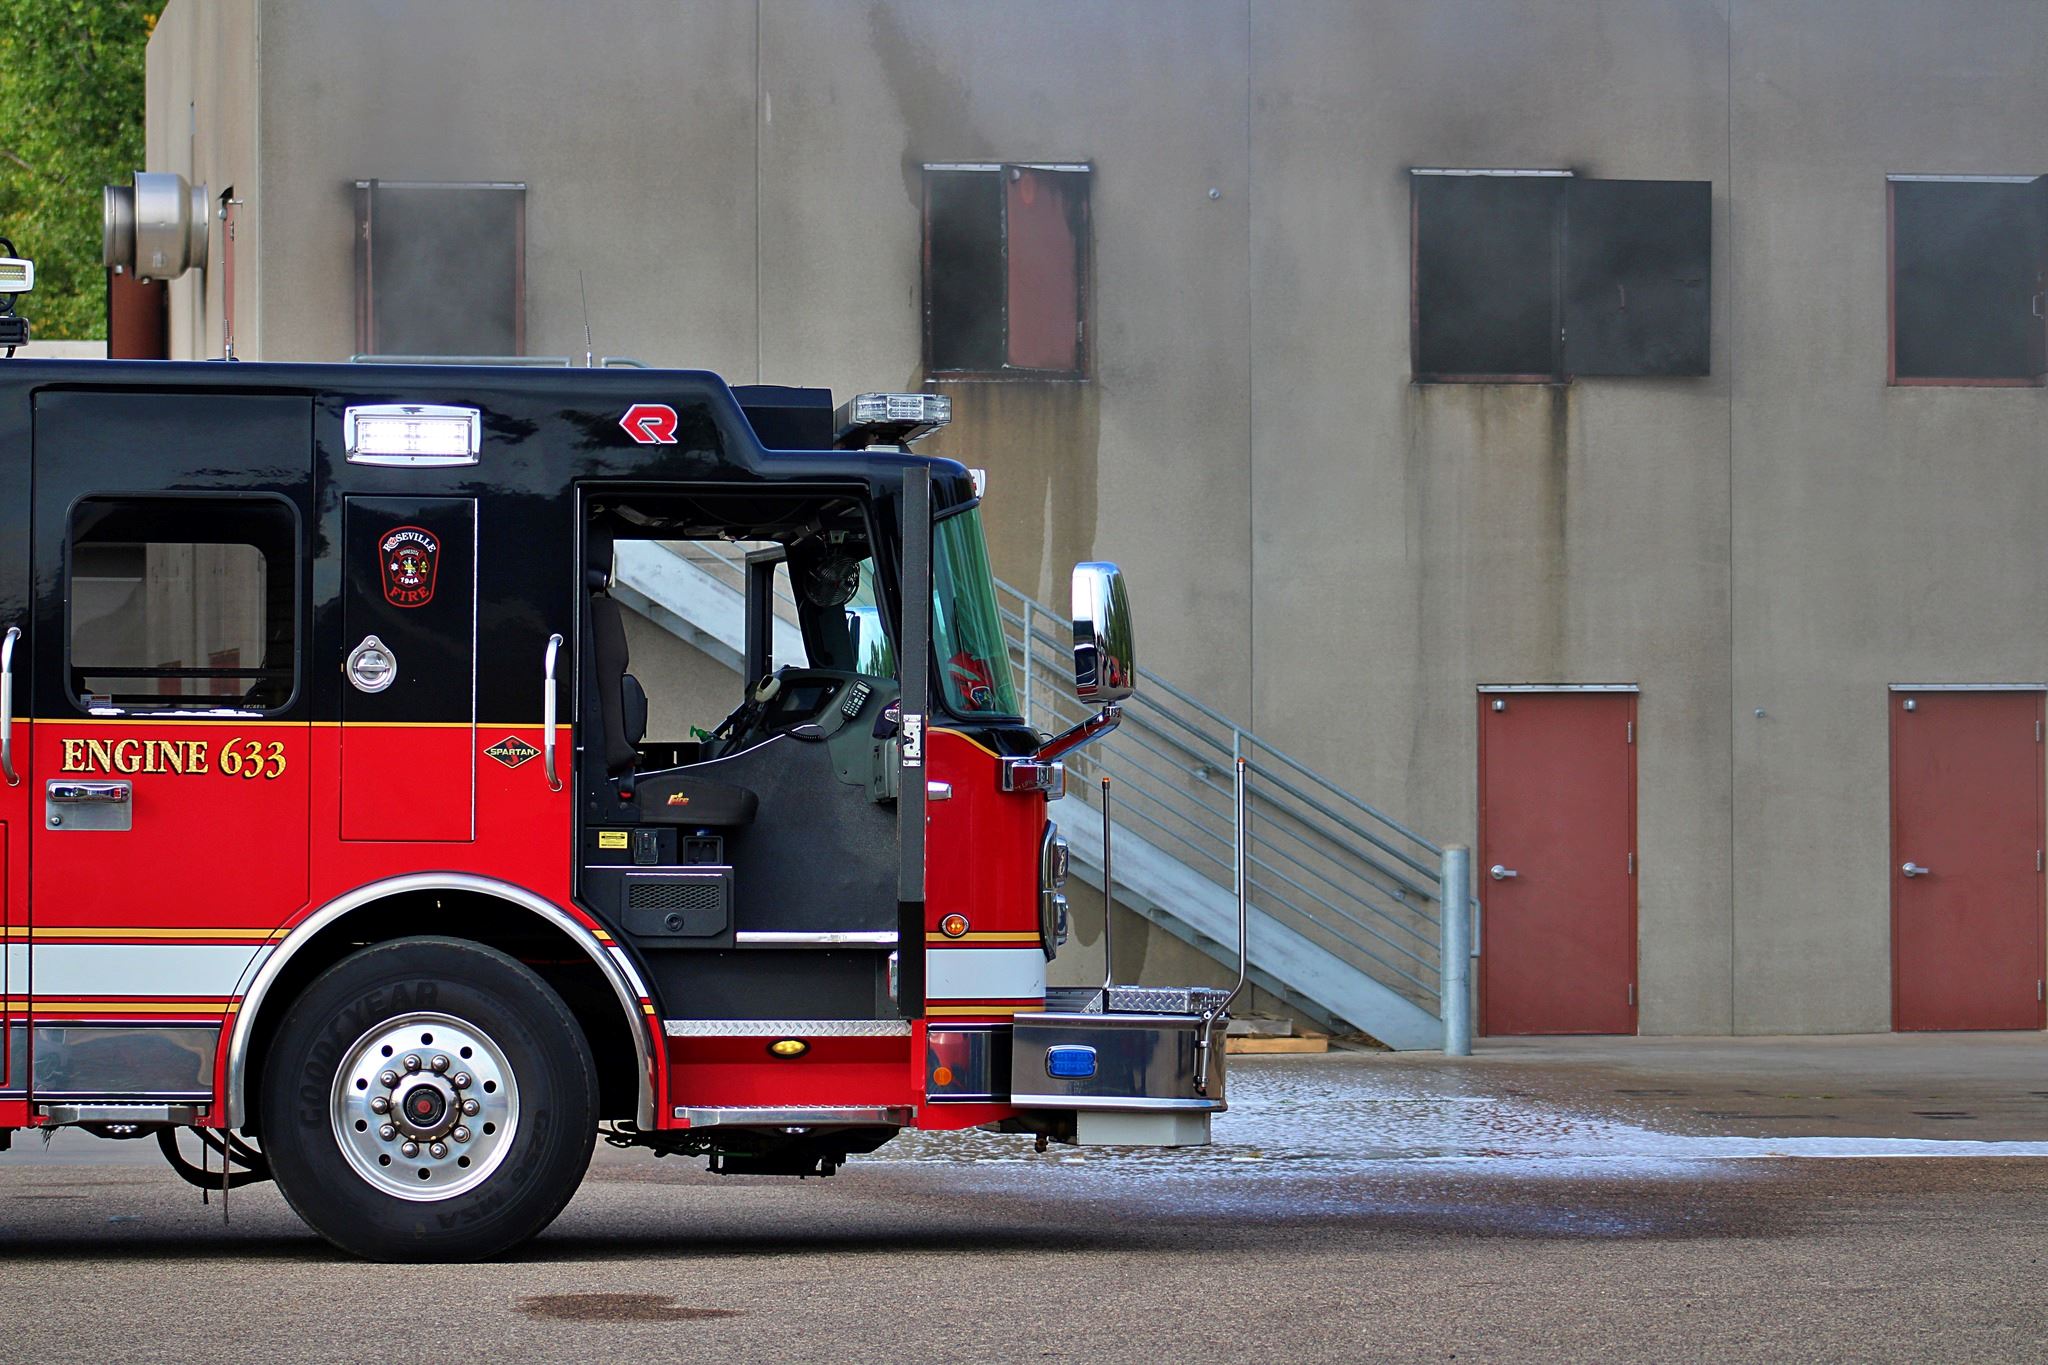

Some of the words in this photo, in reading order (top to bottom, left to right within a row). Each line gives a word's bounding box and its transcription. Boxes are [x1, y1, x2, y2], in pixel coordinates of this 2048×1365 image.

[382, 531, 436, 553] ROSEVILLE
[400, 577, 419, 585] 1944
[389, 586, 429, 602] FIRE
[61, 738, 209, 775] ENGINE
[219, 736, 287, 779] 633
[490, 748, 535, 756] SPARTAN
[300, 981, 439, 1129] GOODYEAR
